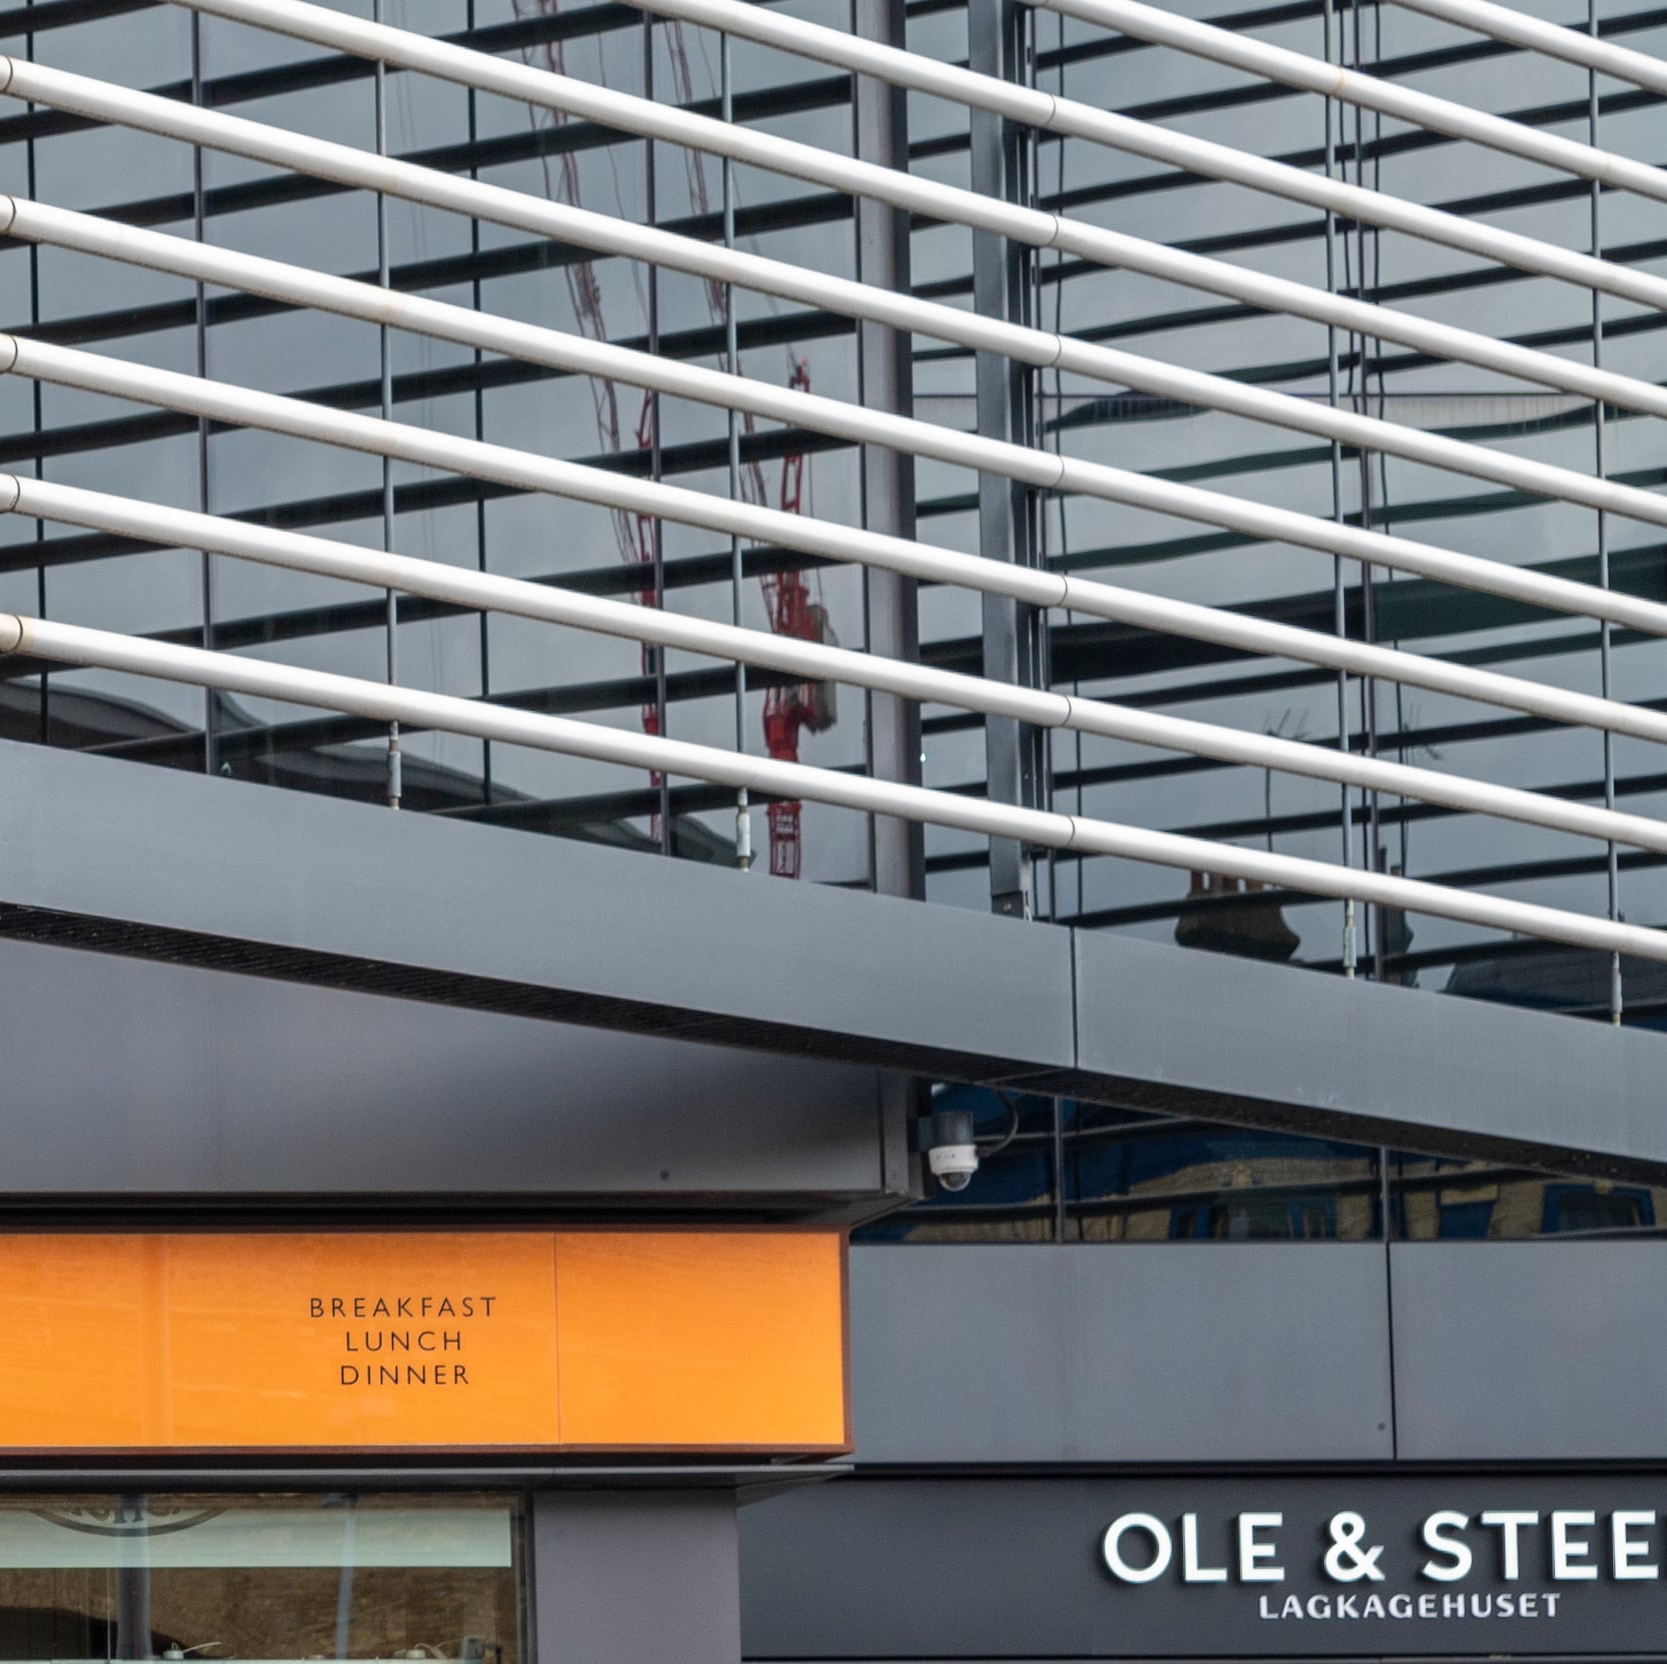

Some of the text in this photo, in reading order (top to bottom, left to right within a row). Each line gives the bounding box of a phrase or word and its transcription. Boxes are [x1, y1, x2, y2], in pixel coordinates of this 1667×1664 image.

[309, 1296, 497, 1318] BREAKFAST
[345, 1330, 463, 1352] LUNCH
[340, 1364, 470, 1386] DINNER
[1102, 1509, 1660, 1584] OLE & STEE
[1259, 1592, 1562, 1620] LAGKAGEHUSET
